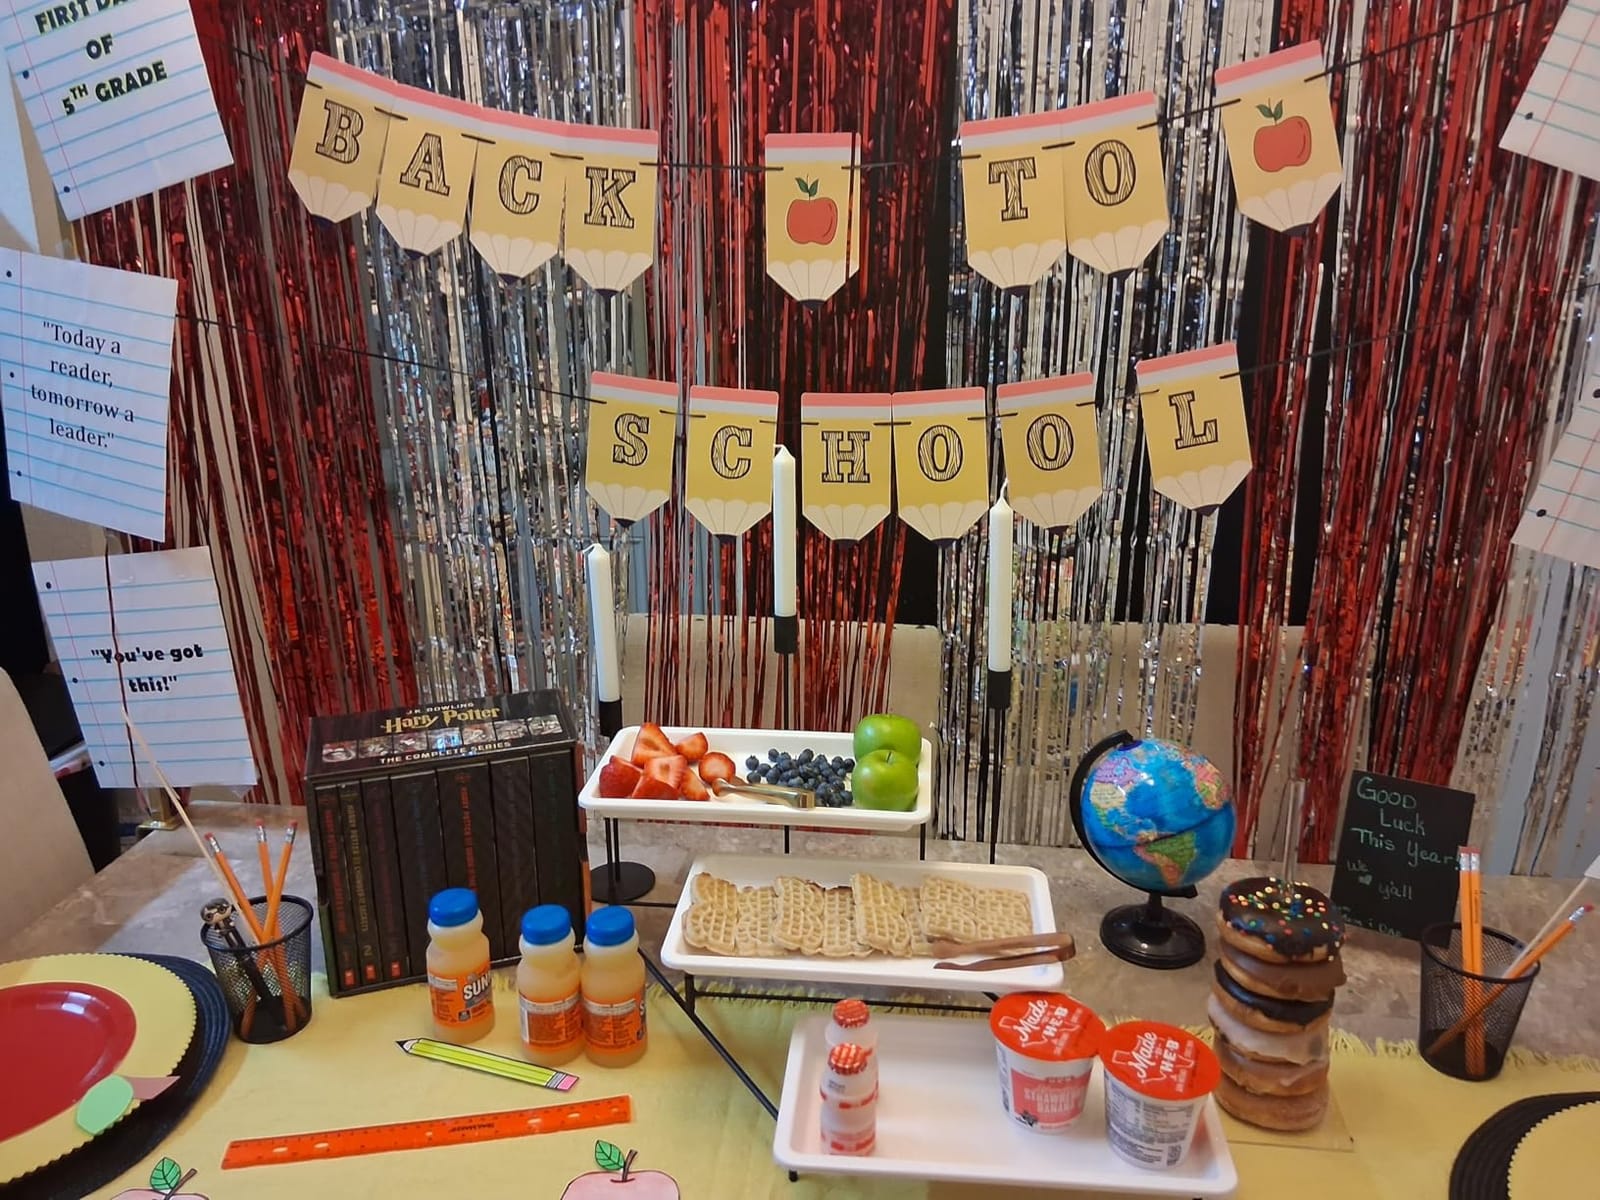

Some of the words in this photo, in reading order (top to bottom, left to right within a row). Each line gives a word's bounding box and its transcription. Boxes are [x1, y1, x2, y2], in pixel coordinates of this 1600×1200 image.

[34, 0, 89, 34] FIRST
[86, 33, 114, 60] OF
[61, 83, 89, 116] 5TH
[95, 60, 168, 102] GRADE
[315, 97, 638, 231] BACK
[988, 138, 1137, 223] TO
[43, 321, 106, 355] "Today
[110, 340, 121, 354] a
[50, 359, 113, 388] reader,
[31, 383, 119, 419] tomorrow
[124, 409, 134, 423] a
[50, 417, 114, 449] leader."
[611, 391, 1220, 485] SCHOOL
[91, 646, 165, 664] "You've
[170, 644, 204, 662] got
[128, 675, 178, 693] this!"
[380, 714, 439, 733] Harry
[442, 706, 500, 727] Potter
[426, 702, 475, 713] ROWLING
[380, 755, 402, 764] THE
[404, 746, 468, 761] COMPLETE
[1357, 776, 1417, 809] GOOD
[1351, 826, 1396, 850] This
[1379, 808, 1426, 836] Luck
[1012, 999, 1049, 1043] Made
[1127, 1032, 1158, 1079] Made
